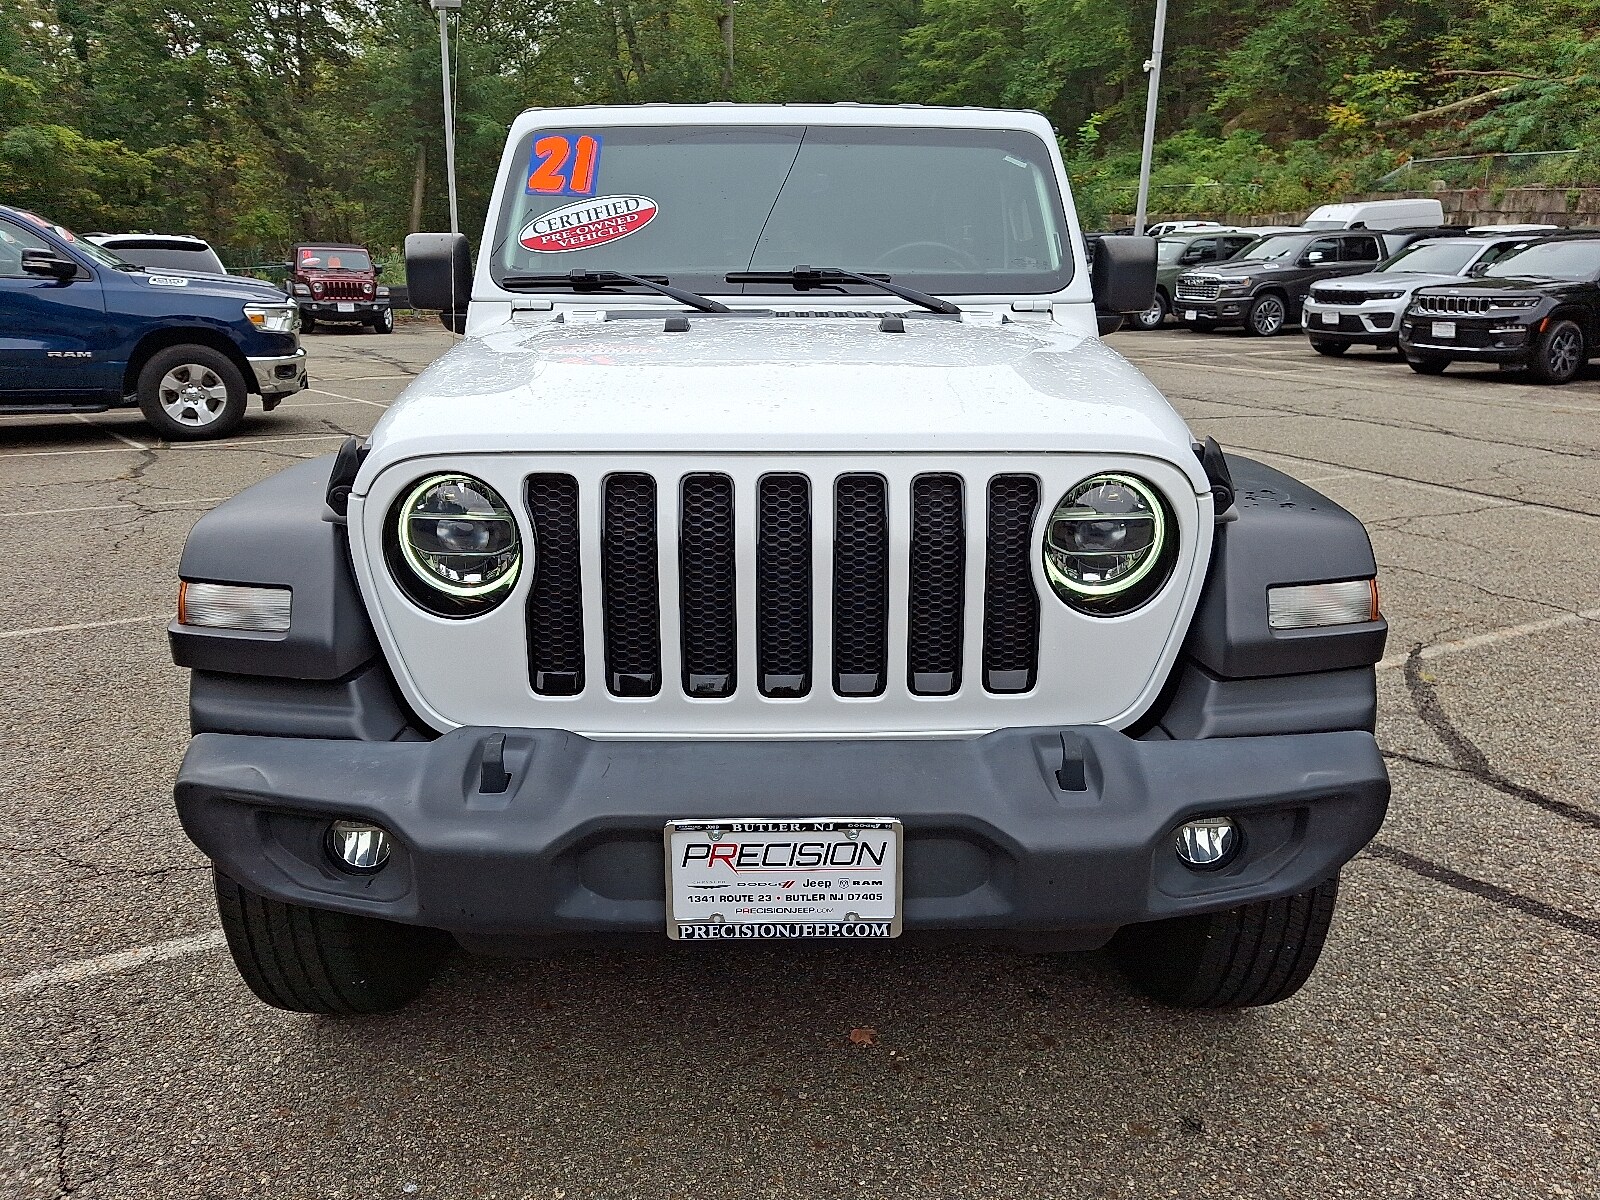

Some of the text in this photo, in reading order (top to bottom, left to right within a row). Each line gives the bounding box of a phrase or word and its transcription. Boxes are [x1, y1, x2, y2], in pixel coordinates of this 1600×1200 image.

[528, 135, 598, 194] 21
[532, 197, 641, 235] CERTIFIED
[541, 213, 639, 244] PRE-OWNED
[558, 223, 628, 247] VEHICLE
[731, 822, 836, 833] BUTLER, NJ
[681, 841, 888, 874] PRECISION
[802, 878, 832, 888] Jeep
[687, 893, 883, 903] 1341 ROUTE 23 BUTLER NJ 07405
[679, 922, 890, 939] PRECISIONJEEP.COM
